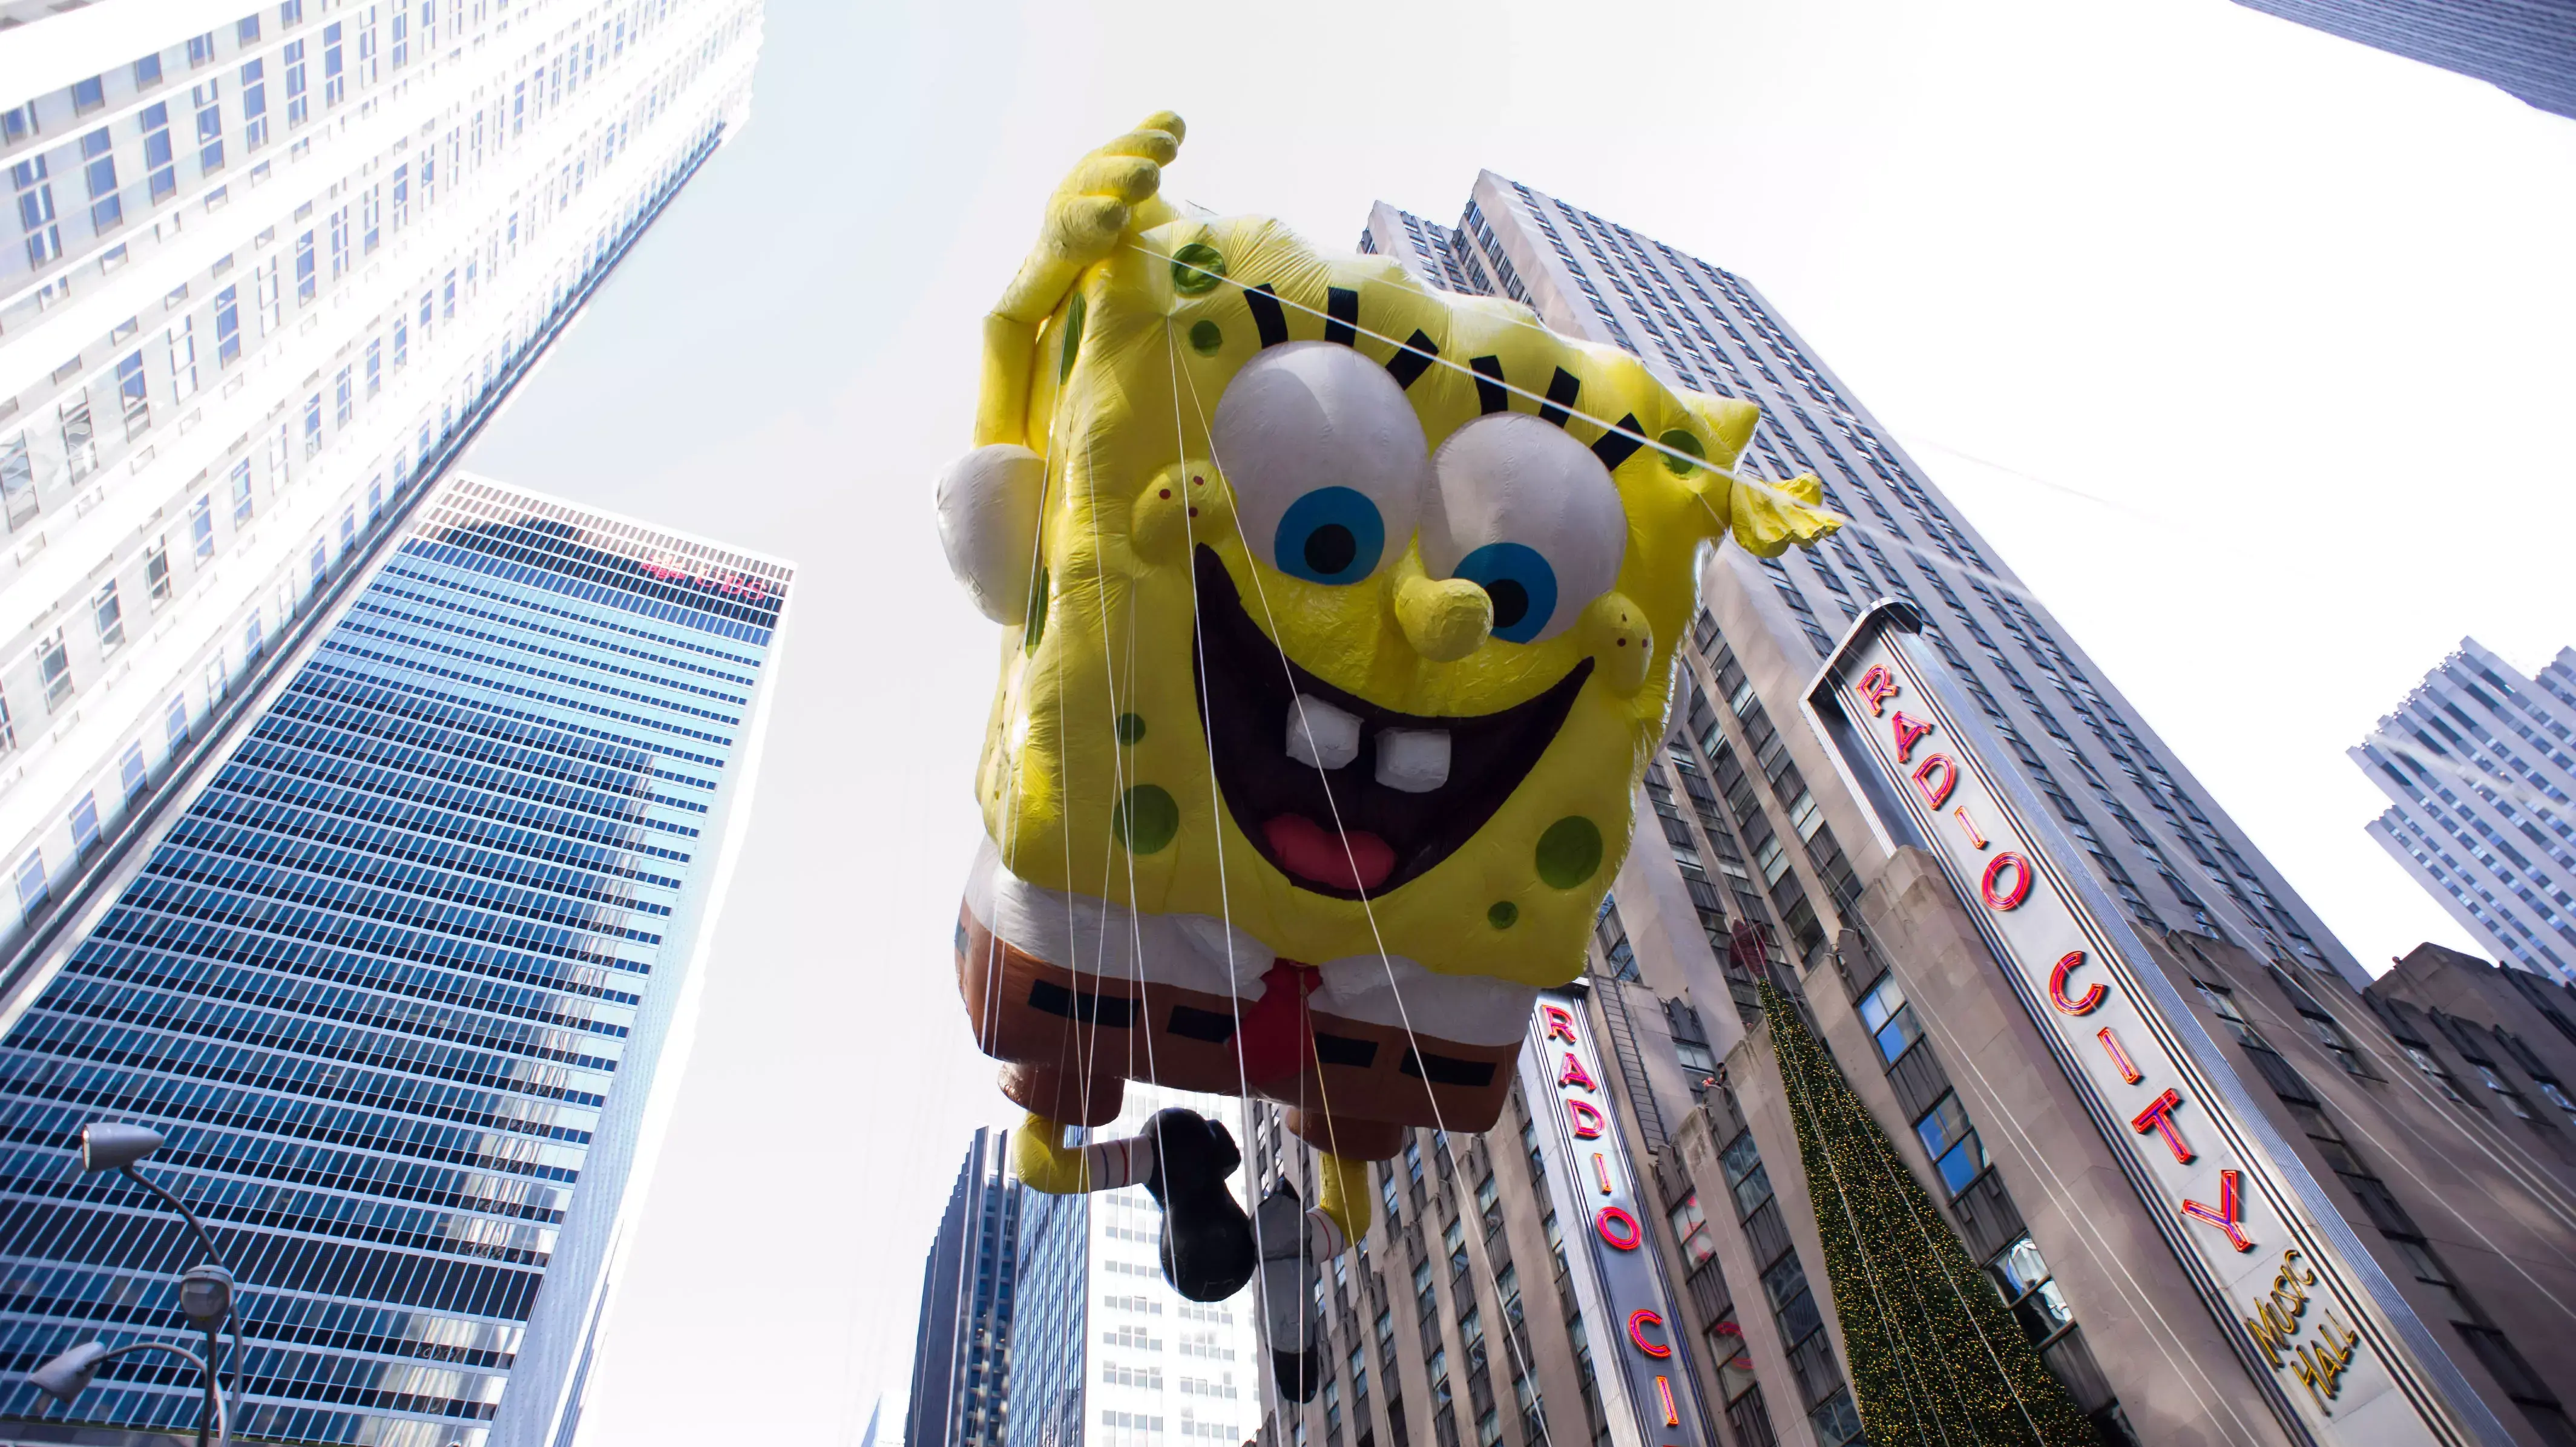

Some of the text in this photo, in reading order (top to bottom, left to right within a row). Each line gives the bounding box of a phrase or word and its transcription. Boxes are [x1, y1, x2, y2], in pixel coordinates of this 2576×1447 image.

[696, 565, 766, 600] UBS
[1856, 663, 2252, 1252] RADIO CITY
[1541, 1005, 1689, 1447] RADIO CI
[2247, 1249, 2314, 1367] MUSIC
[2290, 1308, 2359, 1417] HALL
